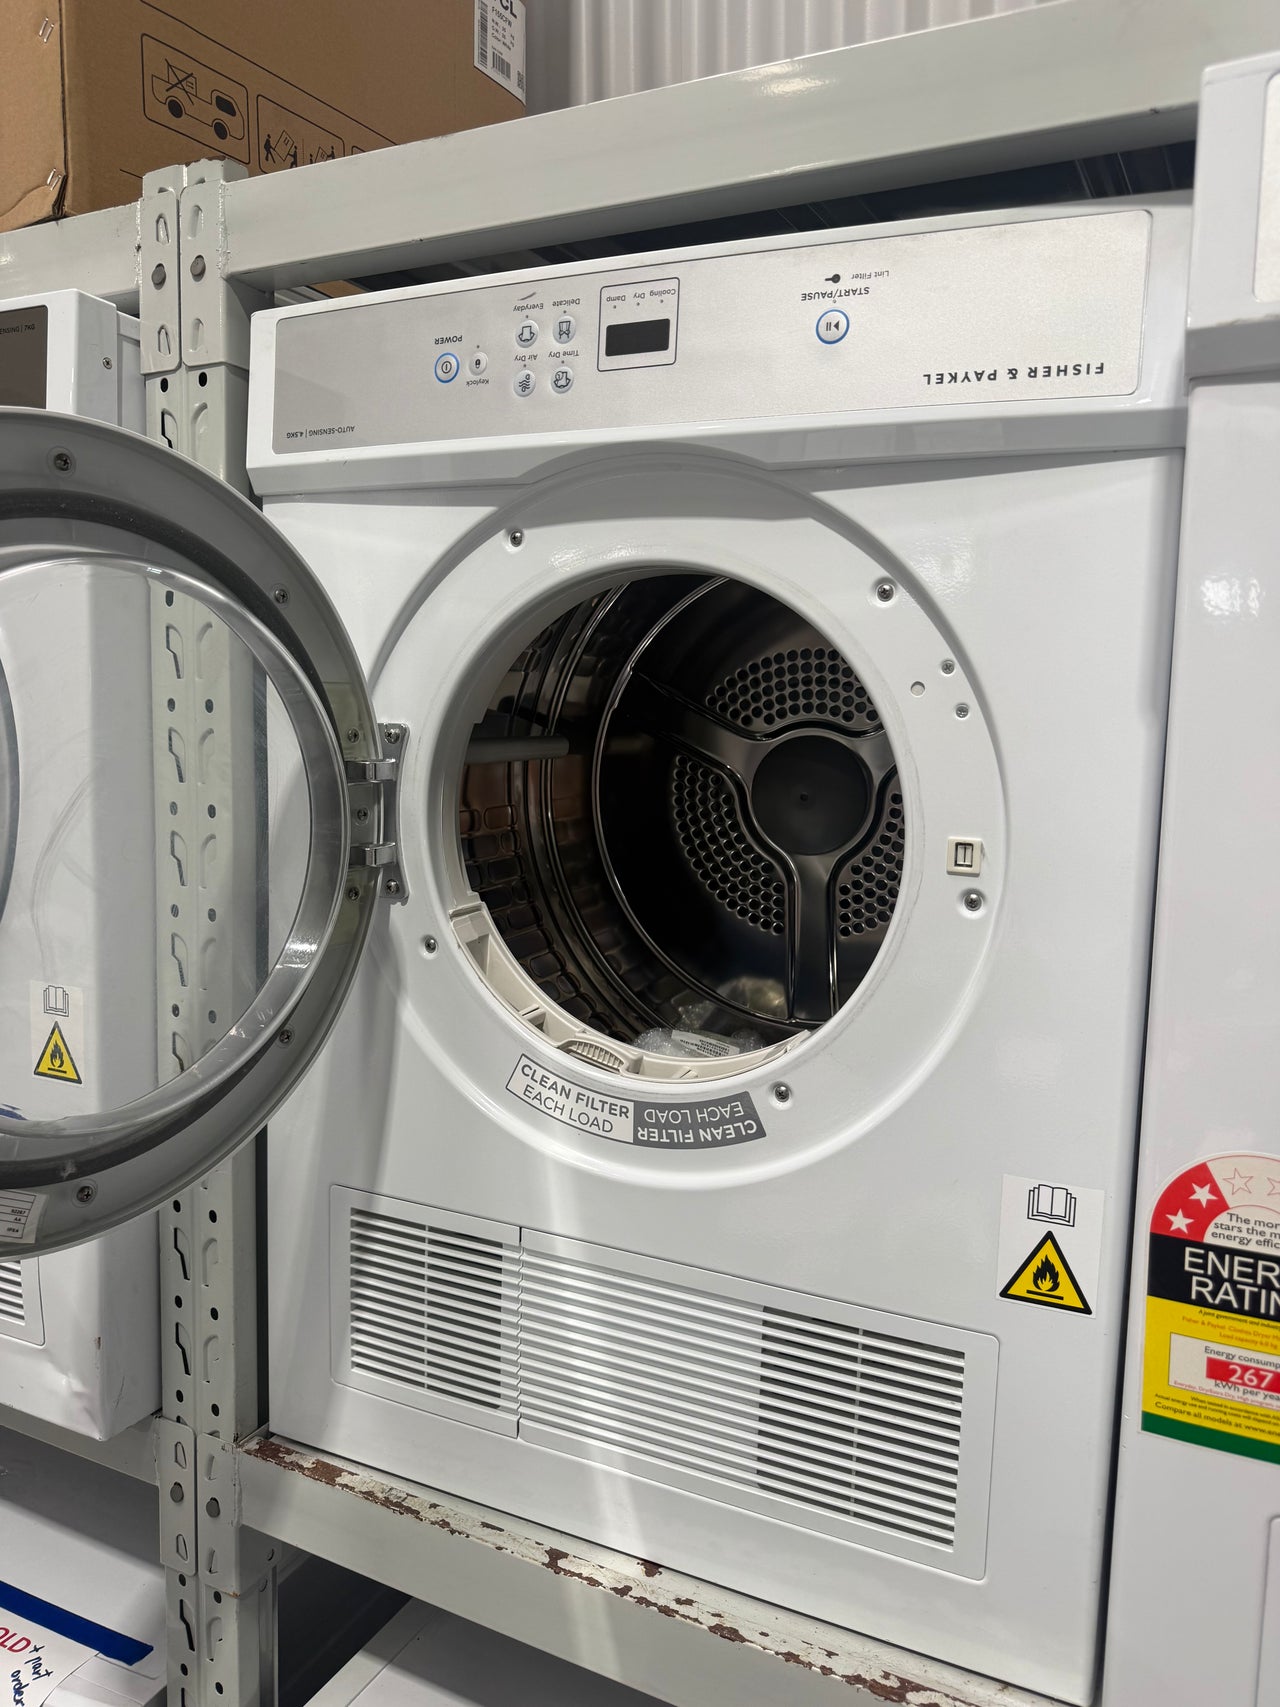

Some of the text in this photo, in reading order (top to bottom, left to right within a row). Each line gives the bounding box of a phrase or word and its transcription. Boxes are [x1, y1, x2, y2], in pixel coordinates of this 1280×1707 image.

[494, 0, 518, 19] CL
[650, 288, 676, 296] Cooling
[801, 287, 870, 301] START/PAUSE
[513, 303, 544, 312] Everyday
[552, 298, 581, 306] Delicate
[434, 335, 463, 345] POWER
[466, 379, 489, 387] Keylock
[923, 362, 1104, 385] FISHER & PAYKEL
[309, 426, 355, 436] AUTO-SENSING
[521, 1064, 630, 1119] CLEAN FILTER
[523, 1084, 614, 1134] EACH LOAD
[644, 1101, 745, 1124] EACH LOAD
[637, 1120, 758, 1143] CLEAN FILTER
[1227, 1212, 1251, 1224] The
[1214, 1222, 1242, 1233] stars
[1247, 1226, 1267, 1237] the
[1212, 1231, 1280, 1249] energy effic
[1184, 1246, 1280, 1288] ENER
[1204, 1346, 1280, 1369] Energy consump
[1228, 1364, 1274, 1388] 267
[1215, 1380, 1240, 1392] kWh
[1242, 1388, 1261, 1398] per
[1155, 1401, 1192, 1416] Compare
[1204, 1414, 1232, 1426] models
[24, 1656, 54, 1680] part
[11, 1670, 29, 1706] order
